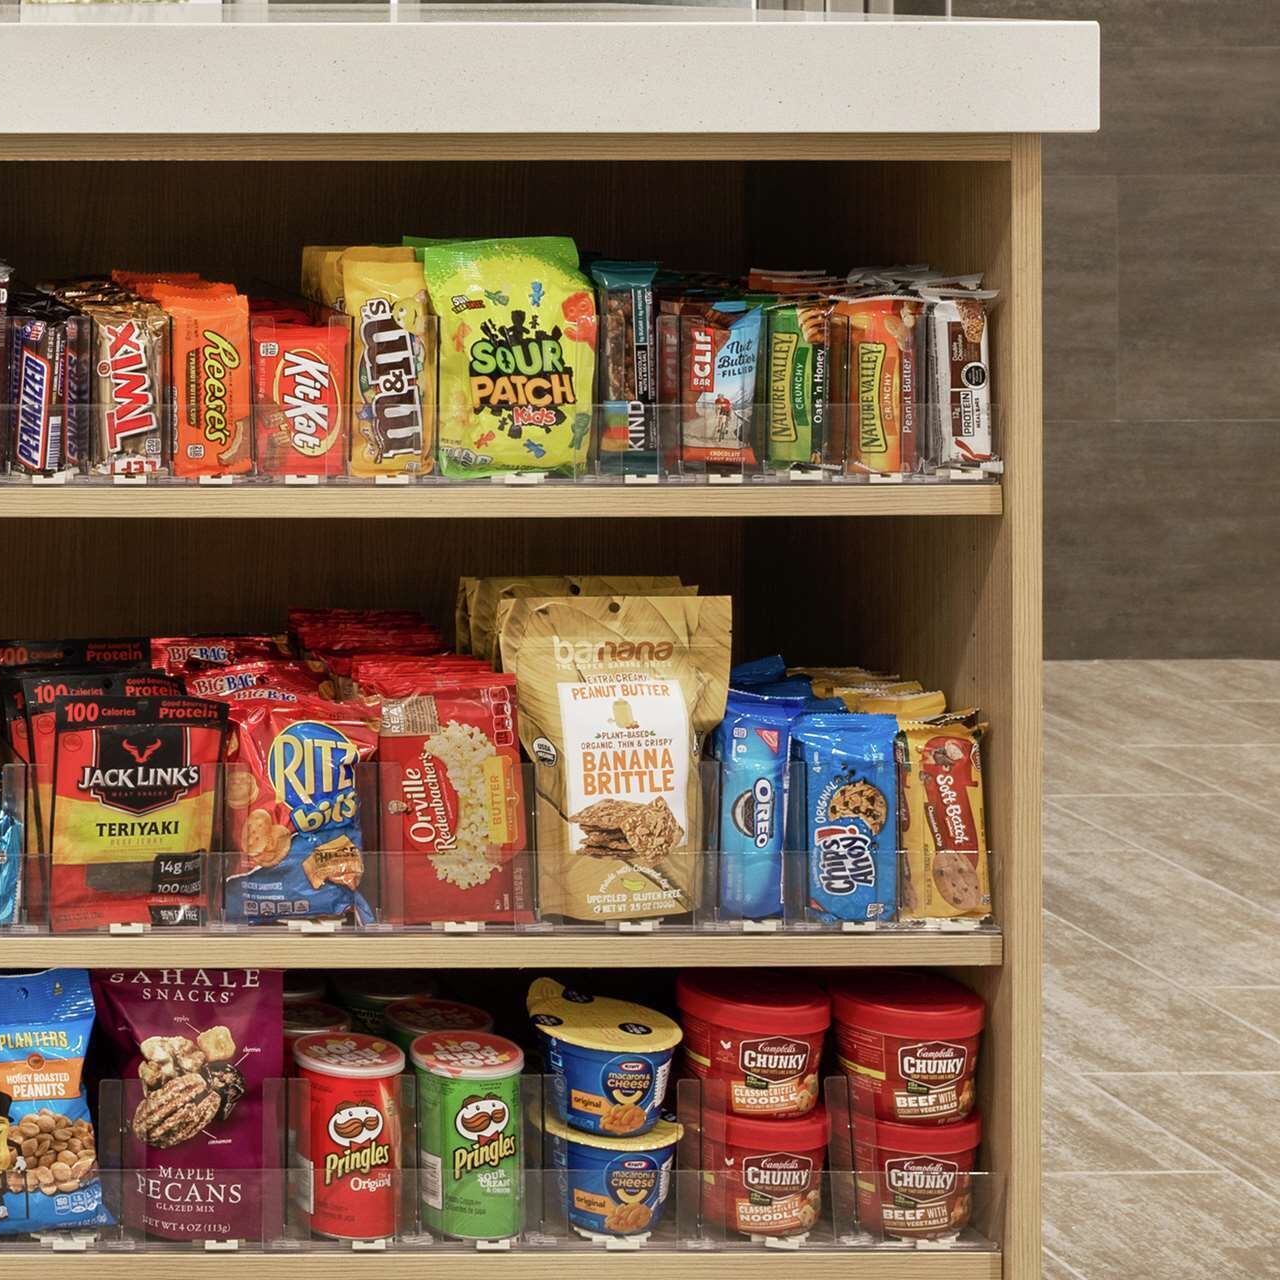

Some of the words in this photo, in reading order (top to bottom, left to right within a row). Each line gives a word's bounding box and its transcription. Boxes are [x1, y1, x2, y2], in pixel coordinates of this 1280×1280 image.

[694, 331, 711, 377] CLIF
[726, 339, 753, 354] Nut
[471, 339, 564, 375] SOUR
[202, 329, 240, 445] Reese's
[470, 375, 576, 405] PATCH
[693, 378, 711, 386] BAR
[17, 356, 47, 467] PENALIZED
[513, 408, 555, 426] Kids
[903, 397, 912, 433] Peanut
[963, 392, 972, 434] PROTEIN
[627, 400, 645, 451] KIND
[86, 650, 142, 662] Protein
[193, 678, 224, 696] BIG
[226, 673, 256, 690] BAG
[587, 675, 614, 684] EXTRA
[616, 673, 647, 682] CREAMY
[572, 686, 616, 700] PEANUT
[621, 684, 670, 697] BUTTER
[65, 702, 98, 722] 100
[101, 708, 136, 717] Calories
[159, 706, 218, 719] Protein
[602, 731, 649, 739] PLANT-BASED
[645, 738, 672, 746] CRISPY
[274, 734, 359, 805] RITZ
[583, 748, 674, 771] BANANA
[79, 767, 135, 789] JACK
[138, 766, 199, 787] LINK'S
[583, 770, 674, 795] BRITTLE
[937, 774, 957, 804] Soft
[402, 768, 436, 843] Orville
[420, 752, 456, 852] Redenbacher's
[493, 775, 502, 826] BUTTER
[293, 793, 359, 835] bits
[753, 778, 775, 849] OREO
[96, 821, 179, 837] TERIYAKI
[946, 805, 968, 844] Batch
[822, 839, 849, 894] Chips
[110, 969, 260, 988] SAHALE
[142, 988, 230, 1003] SNACKS
[744, 1052, 806, 1069] CHUNKY
[903, 1057, 963, 1074] CHUNKY
[34, 1072, 70, 1084] ROASTED
[12, 1082, 65, 1098] PEANUTS
[735, 1094, 798, 1105] NOODLE
[574, 1095, 602, 1109] original
[896, 1094, 938, 1107] BEEF
[325, 1143, 390, 1185] Pringles
[454, 1133, 515, 1179] Pringles
[159, 1165, 215, 1180] MAPLE
[747, 1167, 810, 1186] CHUNKY
[891, 1169, 954, 1189] CHUNKY
[136, 1174, 242, 1203] PECANS
[156, 1203, 193, 1212] GLAZED
[196, 1204, 215, 1212] MIX
[576, 1194, 606, 1209] original
[740, 1210, 799, 1222] NOODLE
[883, 1209, 926, 1221] BEEF
